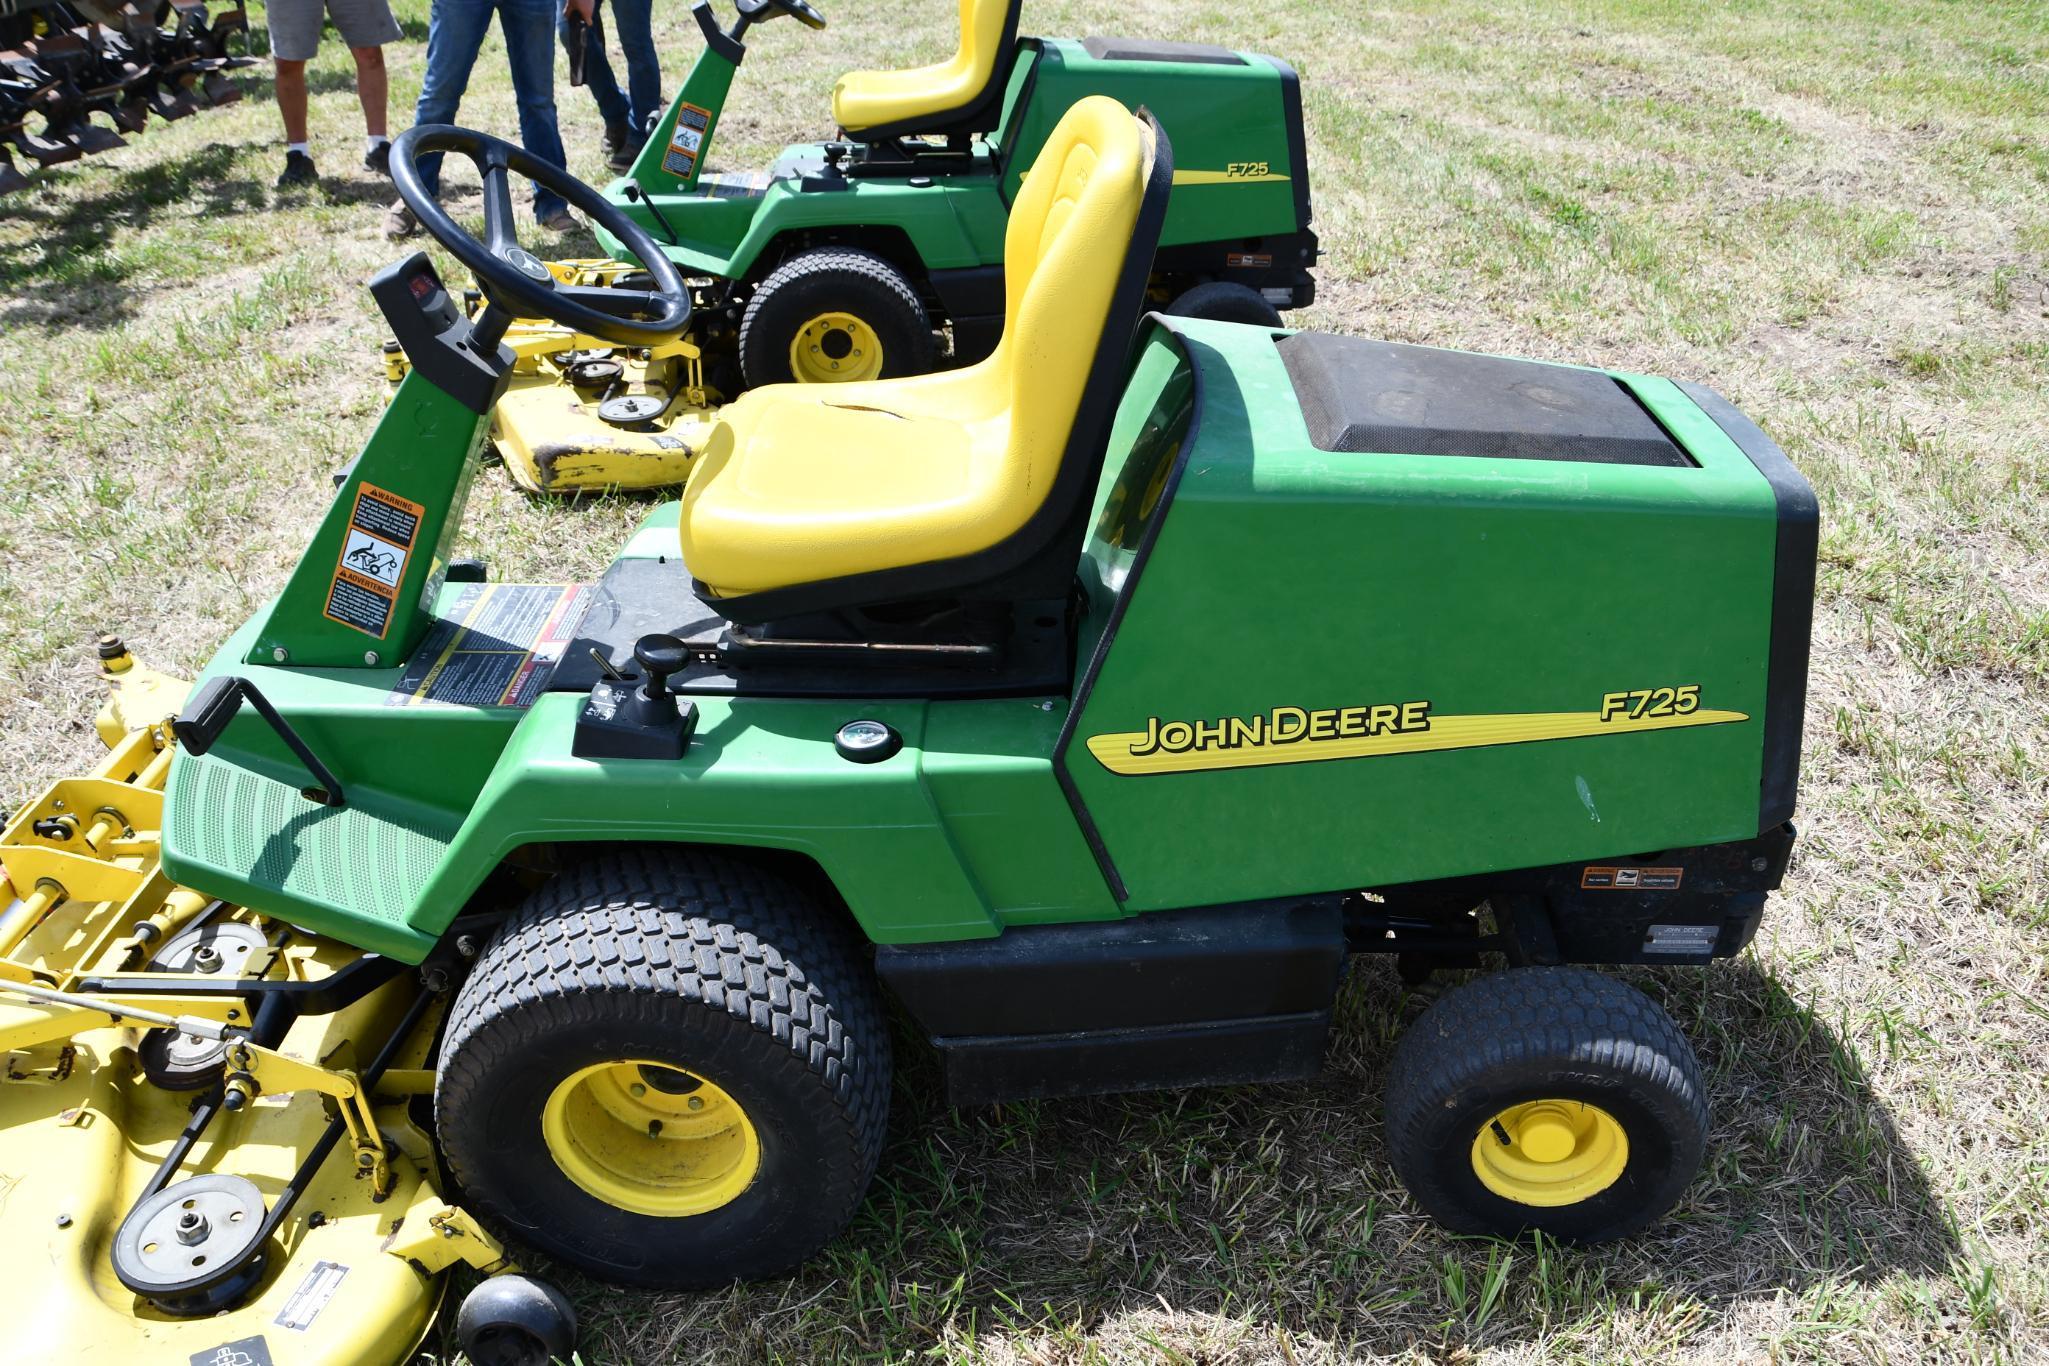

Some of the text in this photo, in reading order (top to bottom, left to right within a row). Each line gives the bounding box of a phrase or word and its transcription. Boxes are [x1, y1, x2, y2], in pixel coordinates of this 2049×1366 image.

[1227, 162, 1269, 177] F725
[378, 491, 413, 511] WARNING
[348, 574, 393, 596] ADVERTENCIA
[1600, 684, 1701, 722] F725
[1130, 701, 1432, 756] JOHN DEERE
